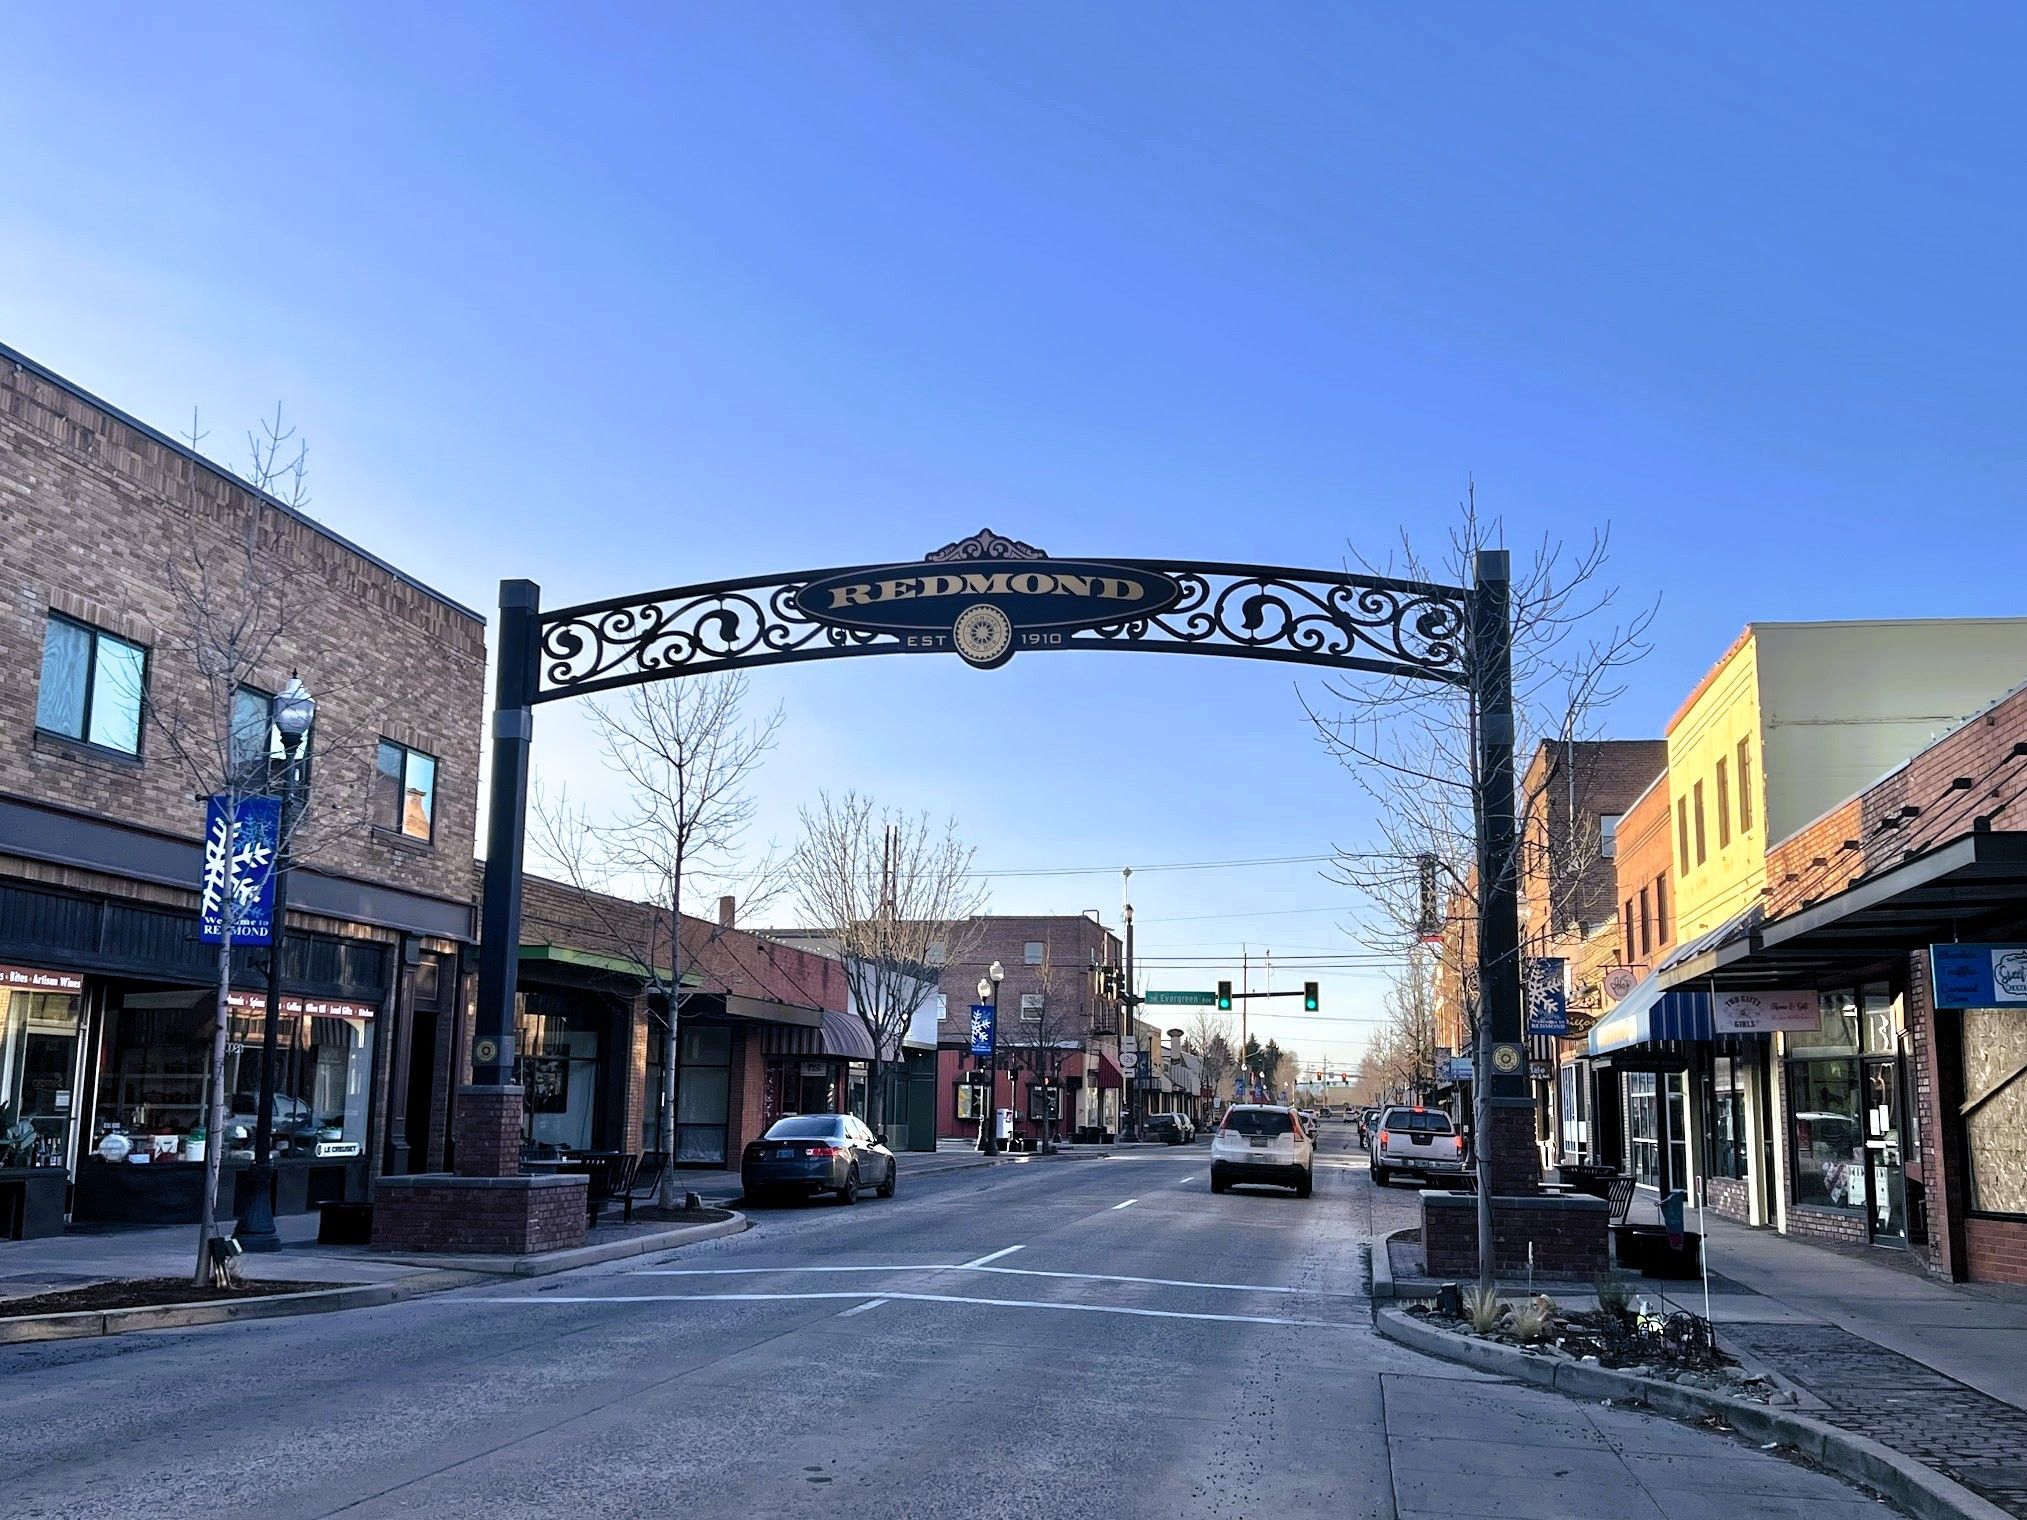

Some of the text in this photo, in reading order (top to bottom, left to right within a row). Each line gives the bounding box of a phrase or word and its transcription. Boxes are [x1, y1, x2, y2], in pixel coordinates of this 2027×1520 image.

[828, 574, 1144, 609] REDMOND
[967, 615, 999, 629] REDMOND
[907, 633, 1062, 646] EST 1910
[204, 925, 269, 937] REMOND
[9, 970, 28, 983] Bites
[32, 974, 58, 986] Artisan
[60, 977, 80, 988] Wines
[1160, 993, 1199, 1004] Evergreen
[286, 1001, 302, 1012] Coffee
[1734, 1020, 1756, 1028] GIRLS
[1123, 1055, 1134, 1063] 126
